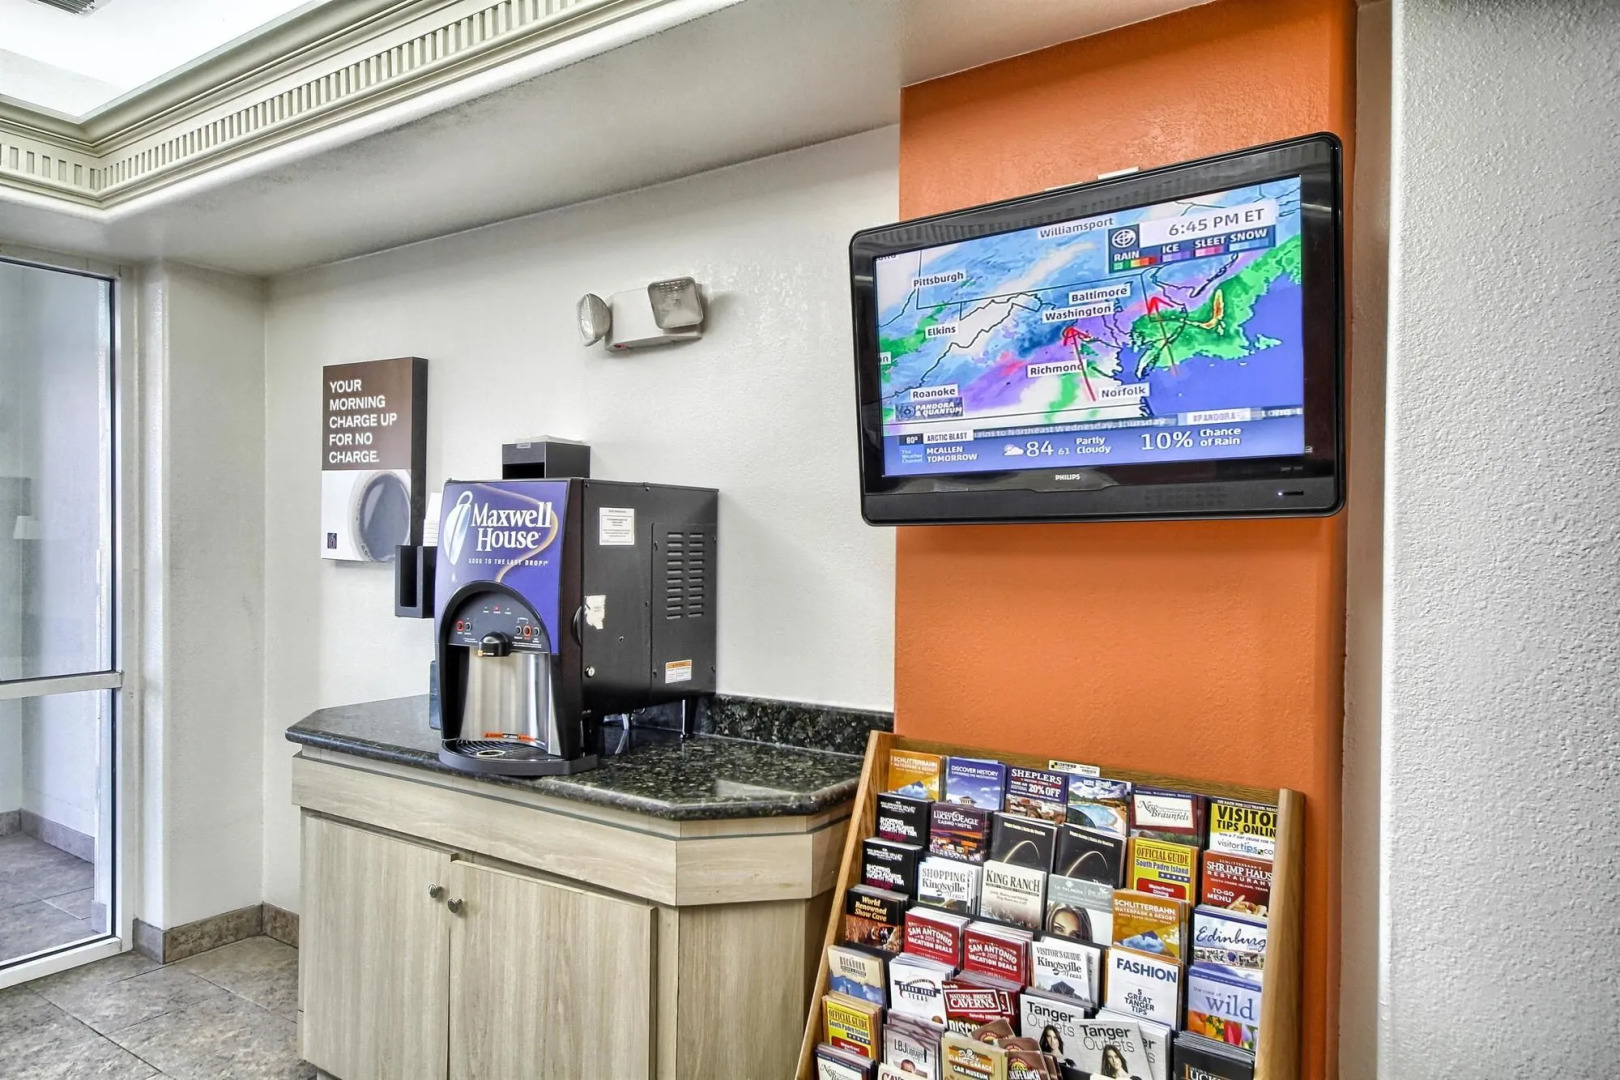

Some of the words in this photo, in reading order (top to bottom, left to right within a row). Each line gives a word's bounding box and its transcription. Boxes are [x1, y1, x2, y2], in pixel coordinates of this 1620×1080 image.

[1039, 217, 1114, 238] Williamsport
[1169, 218, 1208, 237] 6:45
[1213, 212, 1239, 230] PM
[1244, 208, 1265, 224] ET
[1194, 237, 1226, 250] SLEET
[1229, 228, 1269, 244] SNOW
[1113, 250, 1141, 263] RAIN
[1162, 244, 1180, 254] ICE
[913, 271, 964, 289] Pittsburgh
[1071, 287, 1129, 302] Baltimore
[1044, 303, 1113, 322] Washington
[927, 325, 957, 337] Elkins
[1029, 361, 1083, 376] Richmond
[329, 378, 362, 394] YOUR
[912, 386, 957, 399] Roanoke
[1101, 384, 1147, 399] Norfolk
[329, 394, 386, 411] MORNING
[914, 400, 955, 411] PANDORA
[922, 405, 963, 418] QUANTUM
[329, 414, 378, 429] CHARGE
[380, 412, 398, 427] UP
[329, 433, 352, 447] FOR
[354, 431, 373, 446] NO
[926, 433, 948, 444] ARCTIC
[948, 431, 968, 443] BLAST
[1199, 427, 1242, 438] Chance
[1075, 436, 1106, 449] Partly
[1140, 430, 1194, 451] 10%
[1200, 438, 1213, 448] of
[1214, 436, 1241, 448] Rain
[328, 450, 381, 464] CHARGE.
[926, 446, 963, 456] MCALLEN
[1025, 441, 1054, 458] 84
[1057, 448, 1071, 456] 61
[1075, 445, 1111, 458] Cloudy
[926, 453, 978, 464] TOMORROW
[1055, 473, 1081, 481] PHILIPS
[470, 501, 553, 528] Maxwell
[475, 528, 542, 552] House
[506, 559, 523, 567] LAST
[951, 765, 976, 775] DISCOVER
[976, 768, 999, 778] HISTORY
[1011, 768, 1063, 786] SHEPLERS
[1028, 783, 1045, 795] 20%
[1045, 787, 1061, 799] OFF
[1137, 800, 1159, 812] New
[933, 810, 952, 822] LUCKY
[958, 814, 980, 827] EAGLE
[1151, 809, 1190, 822] Braunfels
[937, 819, 955, 828] CASINO
[957, 822, 973, 830] HOTEL
[1216, 819, 1239, 832] TIPS
[1136, 846, 1168, 862] OFFICIAL
[1167, 851, 1190, 865] GUIDE
[1135, 858, 1153, 869] South
[1152, 861, 1170, 872] Padre
[1170, 864, 1190, 875] Island
[1206, 861, 1244, 875] SHRIMP
[1244, 866, 1273, 881] HAUS
[922, 868, 966, 883] SHOPPING
[986, 869, 1009, 886] KING
[1010, 874, 1041, 894] RANCH
[922, 878, 965, 896] Kingsville
[1212, 887, 1235, 898] TO-GO
[861, 895, 882, 907] World
[1206, 892, 1232, 904] MENU
[854, 901, 888, 914] Renowned
[1113, 898, 1176, 915] SCHLITTERBAHN
[854, 908, 872, 919] Show
[872, 912, 888, 922] Cave
[1114, 907, 1147, 917] WATERPARK
[1153, 911, 1176, 922] RESORT
[907, 926, 923, 937] SAN
[923, 927, 953, 947] ANTONIO
[924, 934, 935, 943] 2015
[1195, 926, 1267, 953] Edinburg
[907, 936, 934, 949] VACATION
[934, 943, 953, 954] DEALS
[967, 942, 985, 954] SAN
[985, 944, 1018, 965] ANTONIO
[986, 952, 998, 961] 2015
[1036, 946, 1063, 958] VISITOR'S
[1063, 949, 1081, 961] GUIDE
[967, 953, 998, 967] VACATION
[997, 962, 1018, 973] DEALS
[1036, 956, 1082, 975] Kingsville
[1116, 957, 1177, 983] FASHION
[907, 993, 929, 1003] TEXAS
[1126, 993, 1153, 1004] GREAT
[1137, 989, 1143, 997] 5
[950, 998, 996, 1009] CAVERNS
[1125, 997, 1155, 1012] TANGER
[1131, 1005, 1148, 1016] TIPS
[1205, 994, 1255, 1021] wild
[828, 1008, 852, 1024] OFFICIAL
[1027, 1000, 1074, 1024] Tanger
[828, 1020, 842, 1030] South
[841, 1024, 855, 1033] Padre
[855, 1028, 870, 1038] Island
[1027, 1013, 1075, 1038] Outlets
[1080, 1024, 1131, 1042] Tanger
[1083, 1037, 1135, 1054] Outlets
[953, 1064, 966, 1073] CAR
[966, 1067, 989, 1080] MUSEUM
